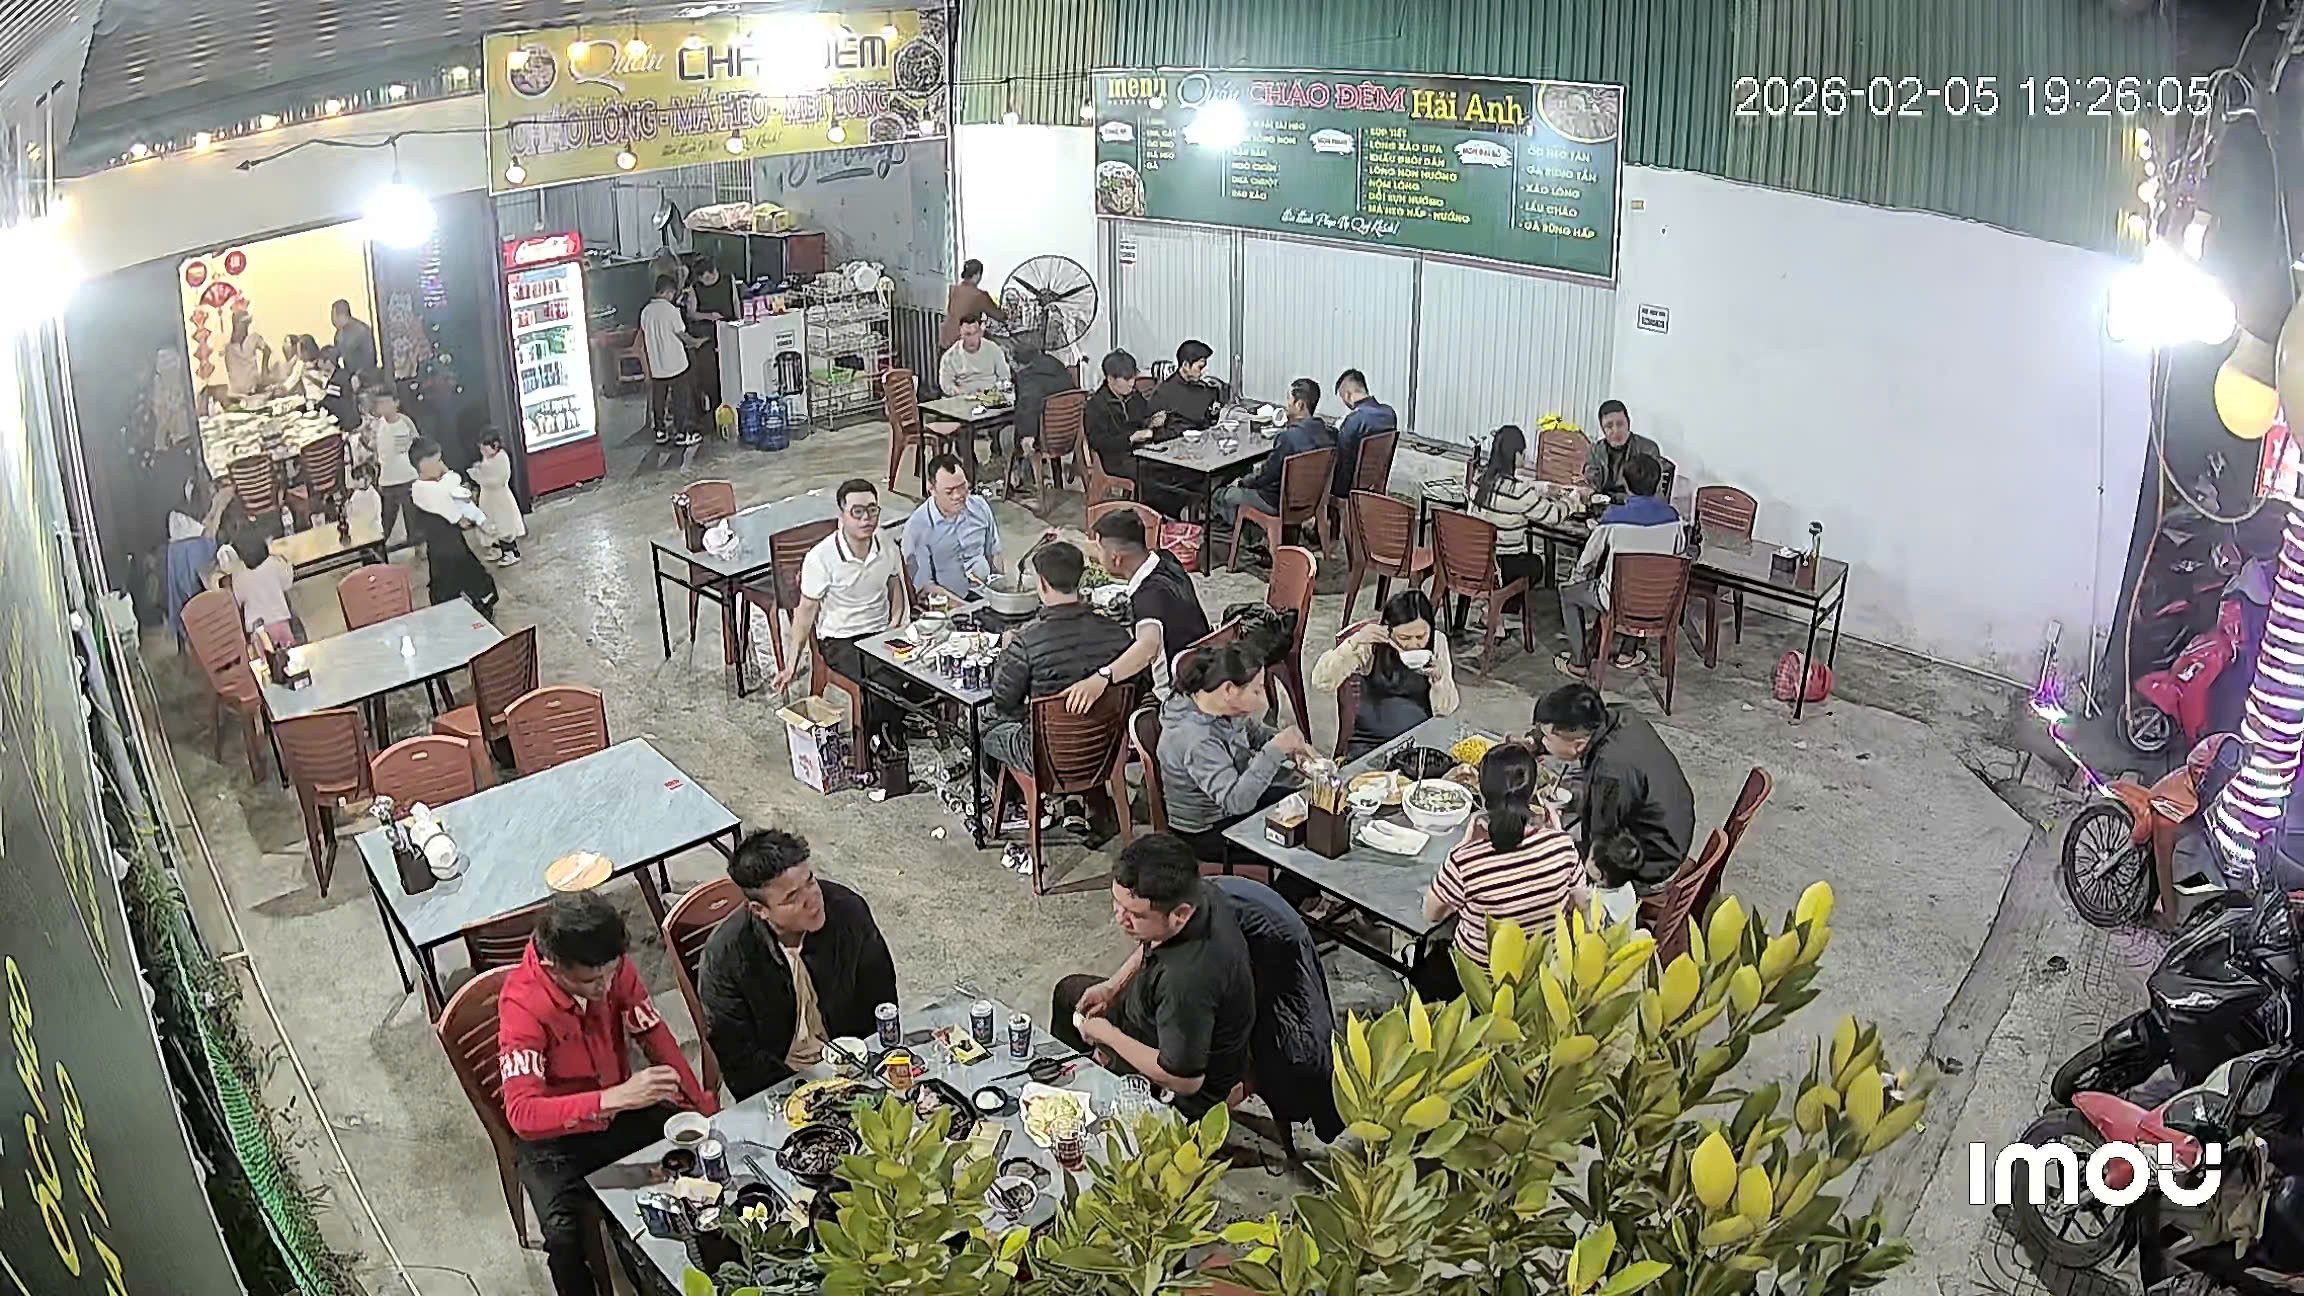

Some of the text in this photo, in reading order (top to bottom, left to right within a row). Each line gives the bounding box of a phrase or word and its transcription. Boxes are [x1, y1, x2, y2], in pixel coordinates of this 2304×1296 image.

[1107, 77, 1167, 98] menu
[1249, 78, 1329, 109] CHÁO
[1334, 81, 1406, 112] ĐÊM
[1410, 89, 1458, 121] Hải
[1463, 93, 1528, 126] Anh
